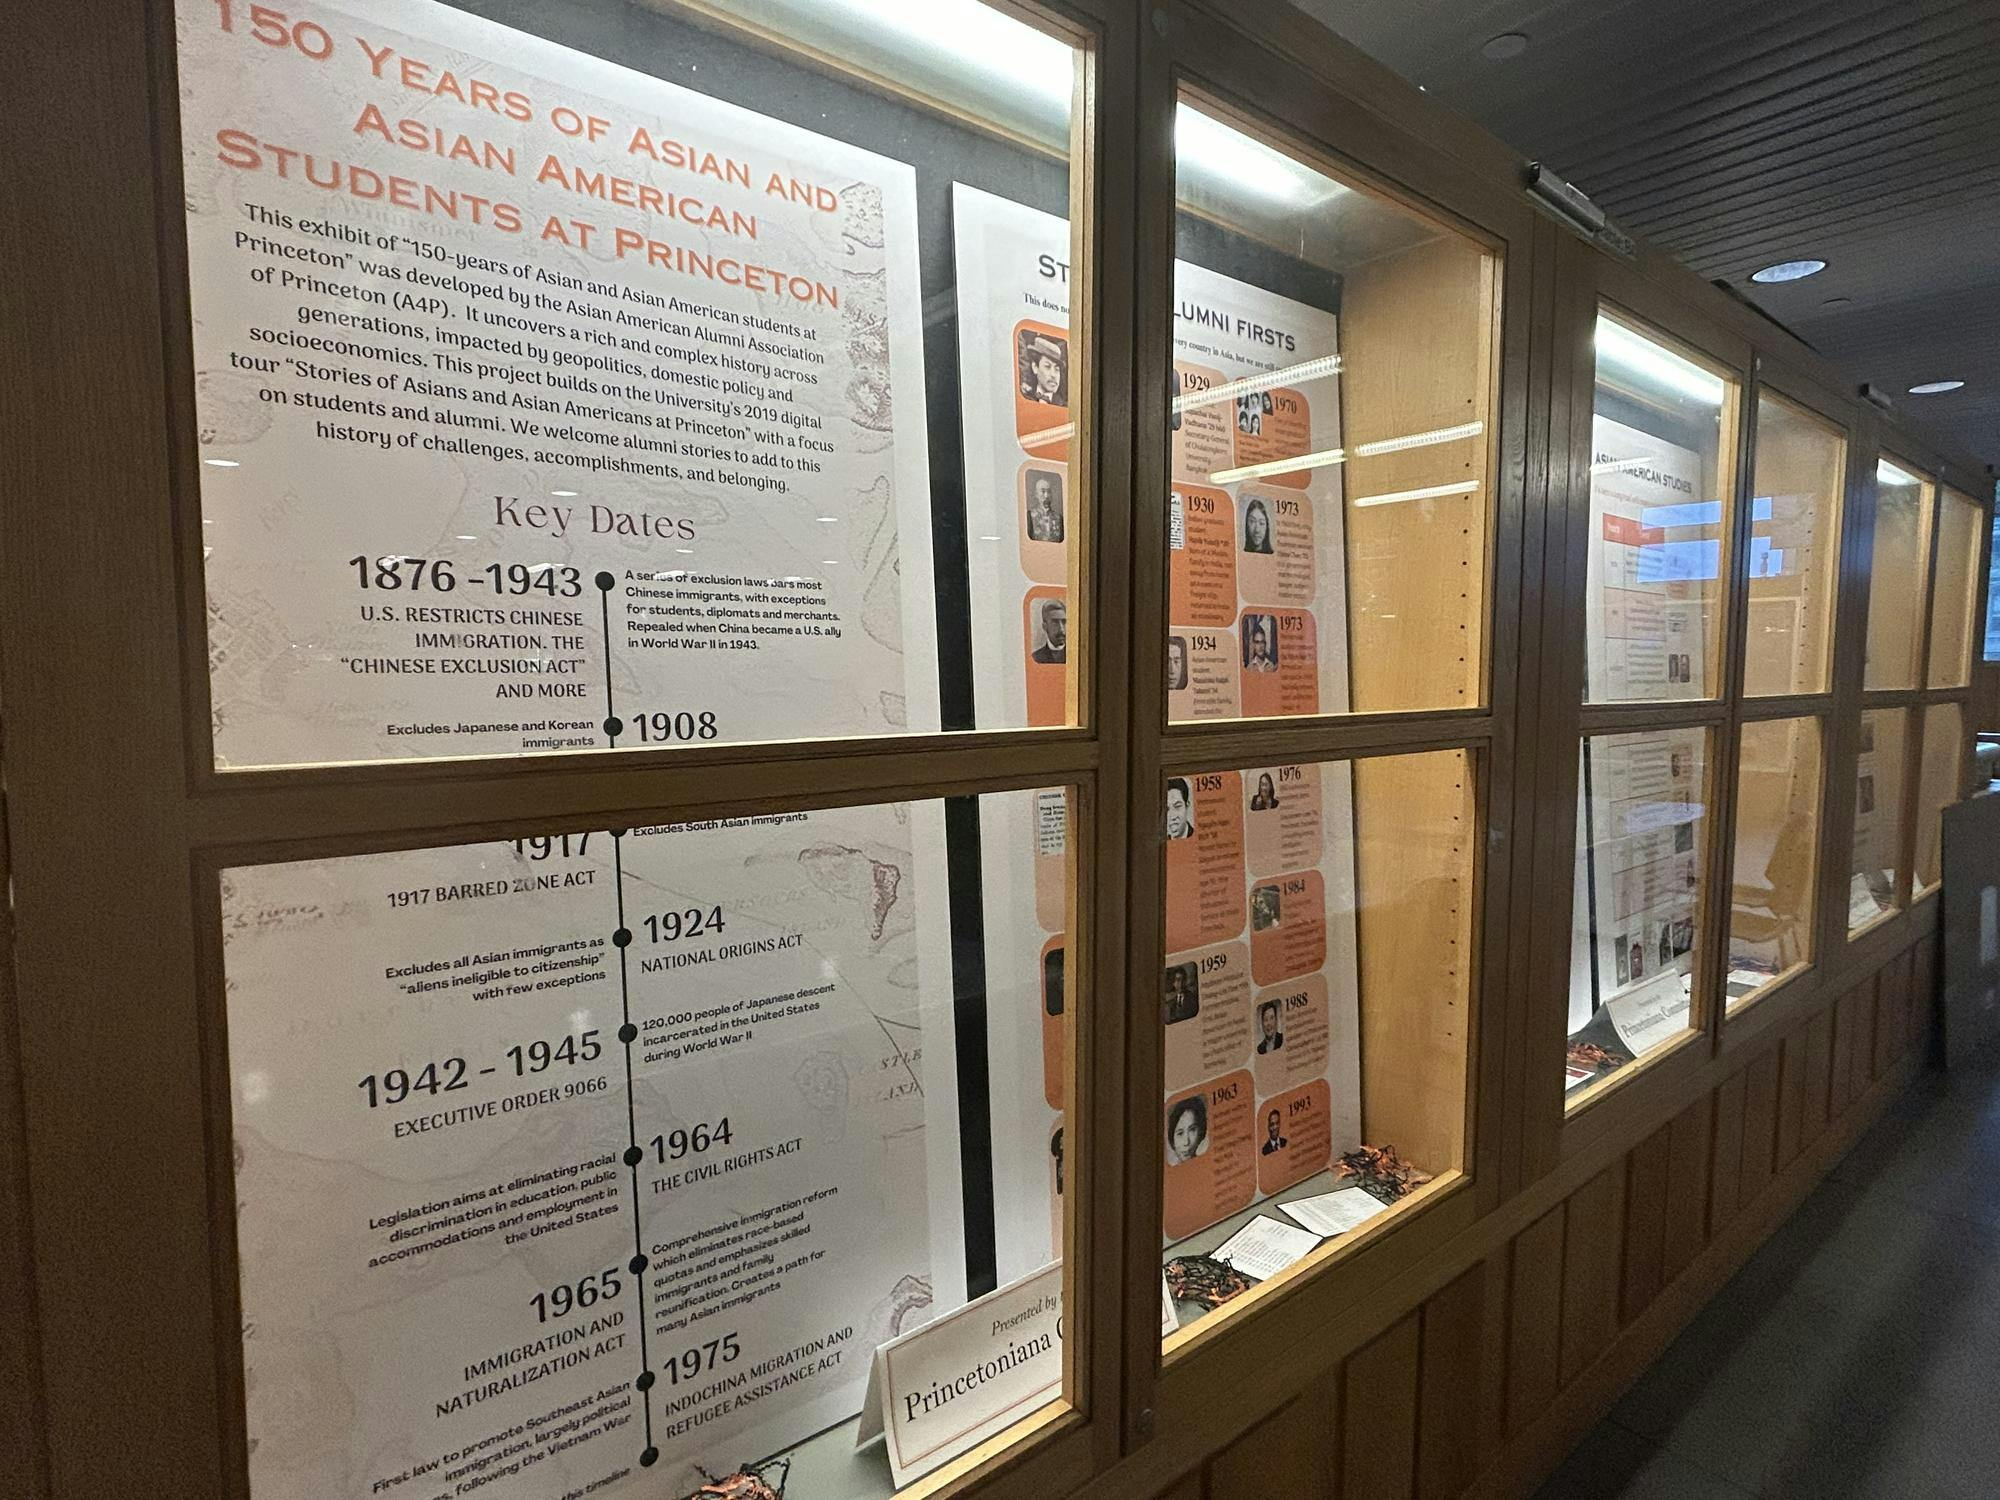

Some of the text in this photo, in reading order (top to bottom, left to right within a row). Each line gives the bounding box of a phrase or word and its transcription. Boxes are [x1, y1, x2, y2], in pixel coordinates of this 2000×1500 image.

[214, 0, 842, 213] 150 YEARS OF ASIAN AND
[352, 103, 757, 240] ASIAN AMERICAN
[216, 129, 839, 313] STUDENTS AT PRINCETON
[244, 203, 293, 229] This
[299, 219, 371, 246] exhibit
[377, 235, 399, 251] of
[512, 264, 532, 280] of
[536, 268, 583, 291] Asian
[587, 282, 618, 299] and
[622, 286, 665, 308] Asian
[668, 297, 739, 324] American
[742, 315, 801, 337] students
[804, 329, 817, 341] at
[358, 260, 401, 280] was
[406, 267, 505, 301] developed
[509, 286, 530, 309] by
[534, 293, 562, 312] the
[566, 299, 612, 322] Asian
[616, 310, 691, 338] American
[694, 326, 745, 348] Alumni
[748, 337, 824, 364] Association
[1023, 291, 1041, 307] This
[1042, 297, 1059, 312] does
[1237, 319, 1296, 352] FIRSTS
[1183, 372, 1210, 391] 1929
[1274, 396, 1297, 414] 1970
[316, 421, 789, 493] history of challenges, accomplishments, and belonging.
[494, 496, 695, 540] Key Dates
[1187, 495, 1215, 514] 1930
[1276, 500, 1299, 517] 1973
[349, 555, 456, 592] 1876
[626, 586, 674, 599] Chinese
[745, 592, 769, 603] with
[770, 595, 826, 607] exceptions
[361, 606, 583, 626] U.S. RESTRICTS CHINESE
[1280, 616, 1303, 631] 1973
[551, 636, 584, 650] THE
[628, 637, 639, 648] in
[640, 638, 679, 648] World
[680, 638, 707, 649] War
[718, 639, 728, 649] in
[1191, 636, 1217, 651] 1934
[441, 659, 542, 674] EXCLUSION
[496, 683, 587, 698] AND MORE
[387, 720, 594, 735] Excludes Japanese and Korean
[632, 711, 718, 742] 1908
[1195, 776, 1222, 792] 1958
[1278, 766, 1301, 782] 1976
[685, 821, 718, 836] South
[721, 818, 749, 834] Asian
[752, 812, 808, 830] immigrants
[387, 889, 431, 908] 1917
[436, 880, 508, 902] BARRED
[564, 870, 596, 887] ACT
[643, 905, 724, 943] 1924
[386, 938, 605, 979] Excludes all Asian immigrants as
[641, 934, 803, 974] NATIONAL ORIGINS ACT
[1200, 954, 1228, 974] 1959
[694, 1004, 731, 1023] people
[732, 1000, 745, 1012] of
[746, 993, 795, 1010] Japanese
[796, 984, 835, 998] descent
[358, 1057, 468, 1108] 1942
[507, 1029, 601, 1077] 1945
[394, 1076, 607, 1138] EXECUTIVE ORDER 9066
[1211, 1083, 1238, 1107] 1963
[650, 1117, 733, 1164] 1964
[651, 1138, 802, 1194] THE CIVIL RIGHTS ACT
[504, 1204, 619, 1245] the United States
[529, 1266, 621, 1323] 1965
[992, 1298, 1043, 1336] Presented
[1045, 1295, 1057, 1311] by
[464, 1311, 624, 1381] IMMIGRATION AND
[663, 1331, 741, 1385] 1975
[436, 1333, 625, 1418] NATURALIZATION ACT
[666, 1326, 853, 1417] INDOCHINA MIGRATION AND
[903, 1331, 1052, 1424] Princetoniana
[666, 1350, 842, 1439] REFUGEE ASSISTANCE ACT
